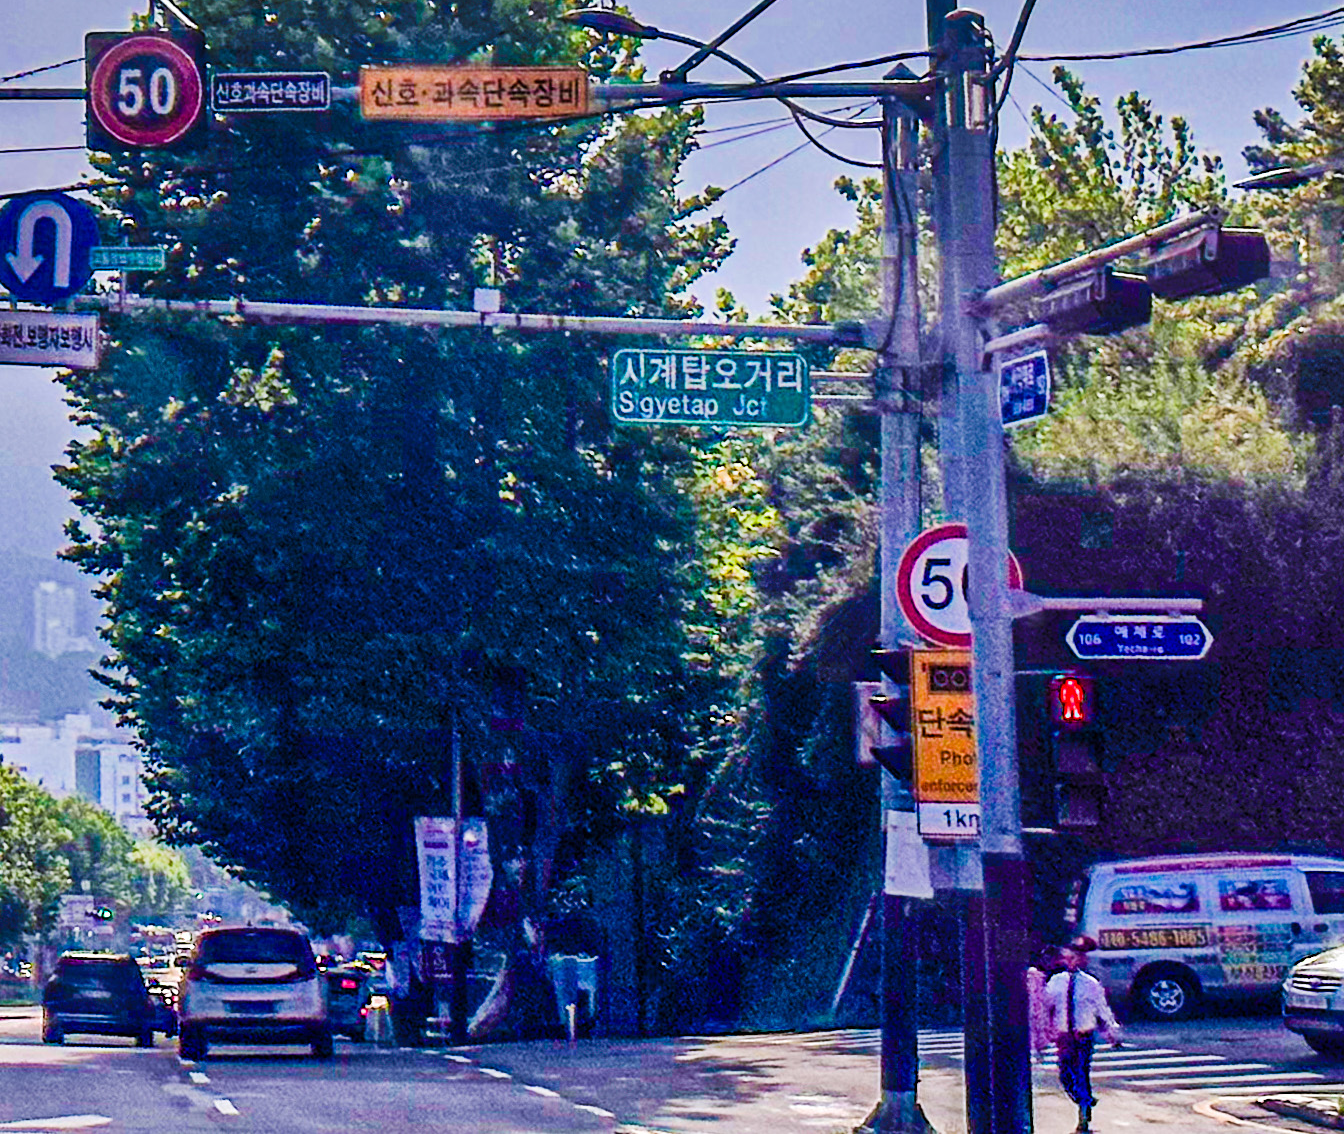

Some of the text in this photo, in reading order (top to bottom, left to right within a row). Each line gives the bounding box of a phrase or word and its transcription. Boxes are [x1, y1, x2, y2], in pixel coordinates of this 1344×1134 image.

[118, 67, 176, 116] 50
[216, 79, 325, 104] 신호과속단속장비
[619, 352, 802, 393] 시계탑오거리
[619, 390, 719, 419] Sigyetap
[920, 558, 969, 611] 5
[1078, 633, 1102, 646] 106
[1179, 633, 1201, 646] 102
[940, 750, 976, 766] Pho
